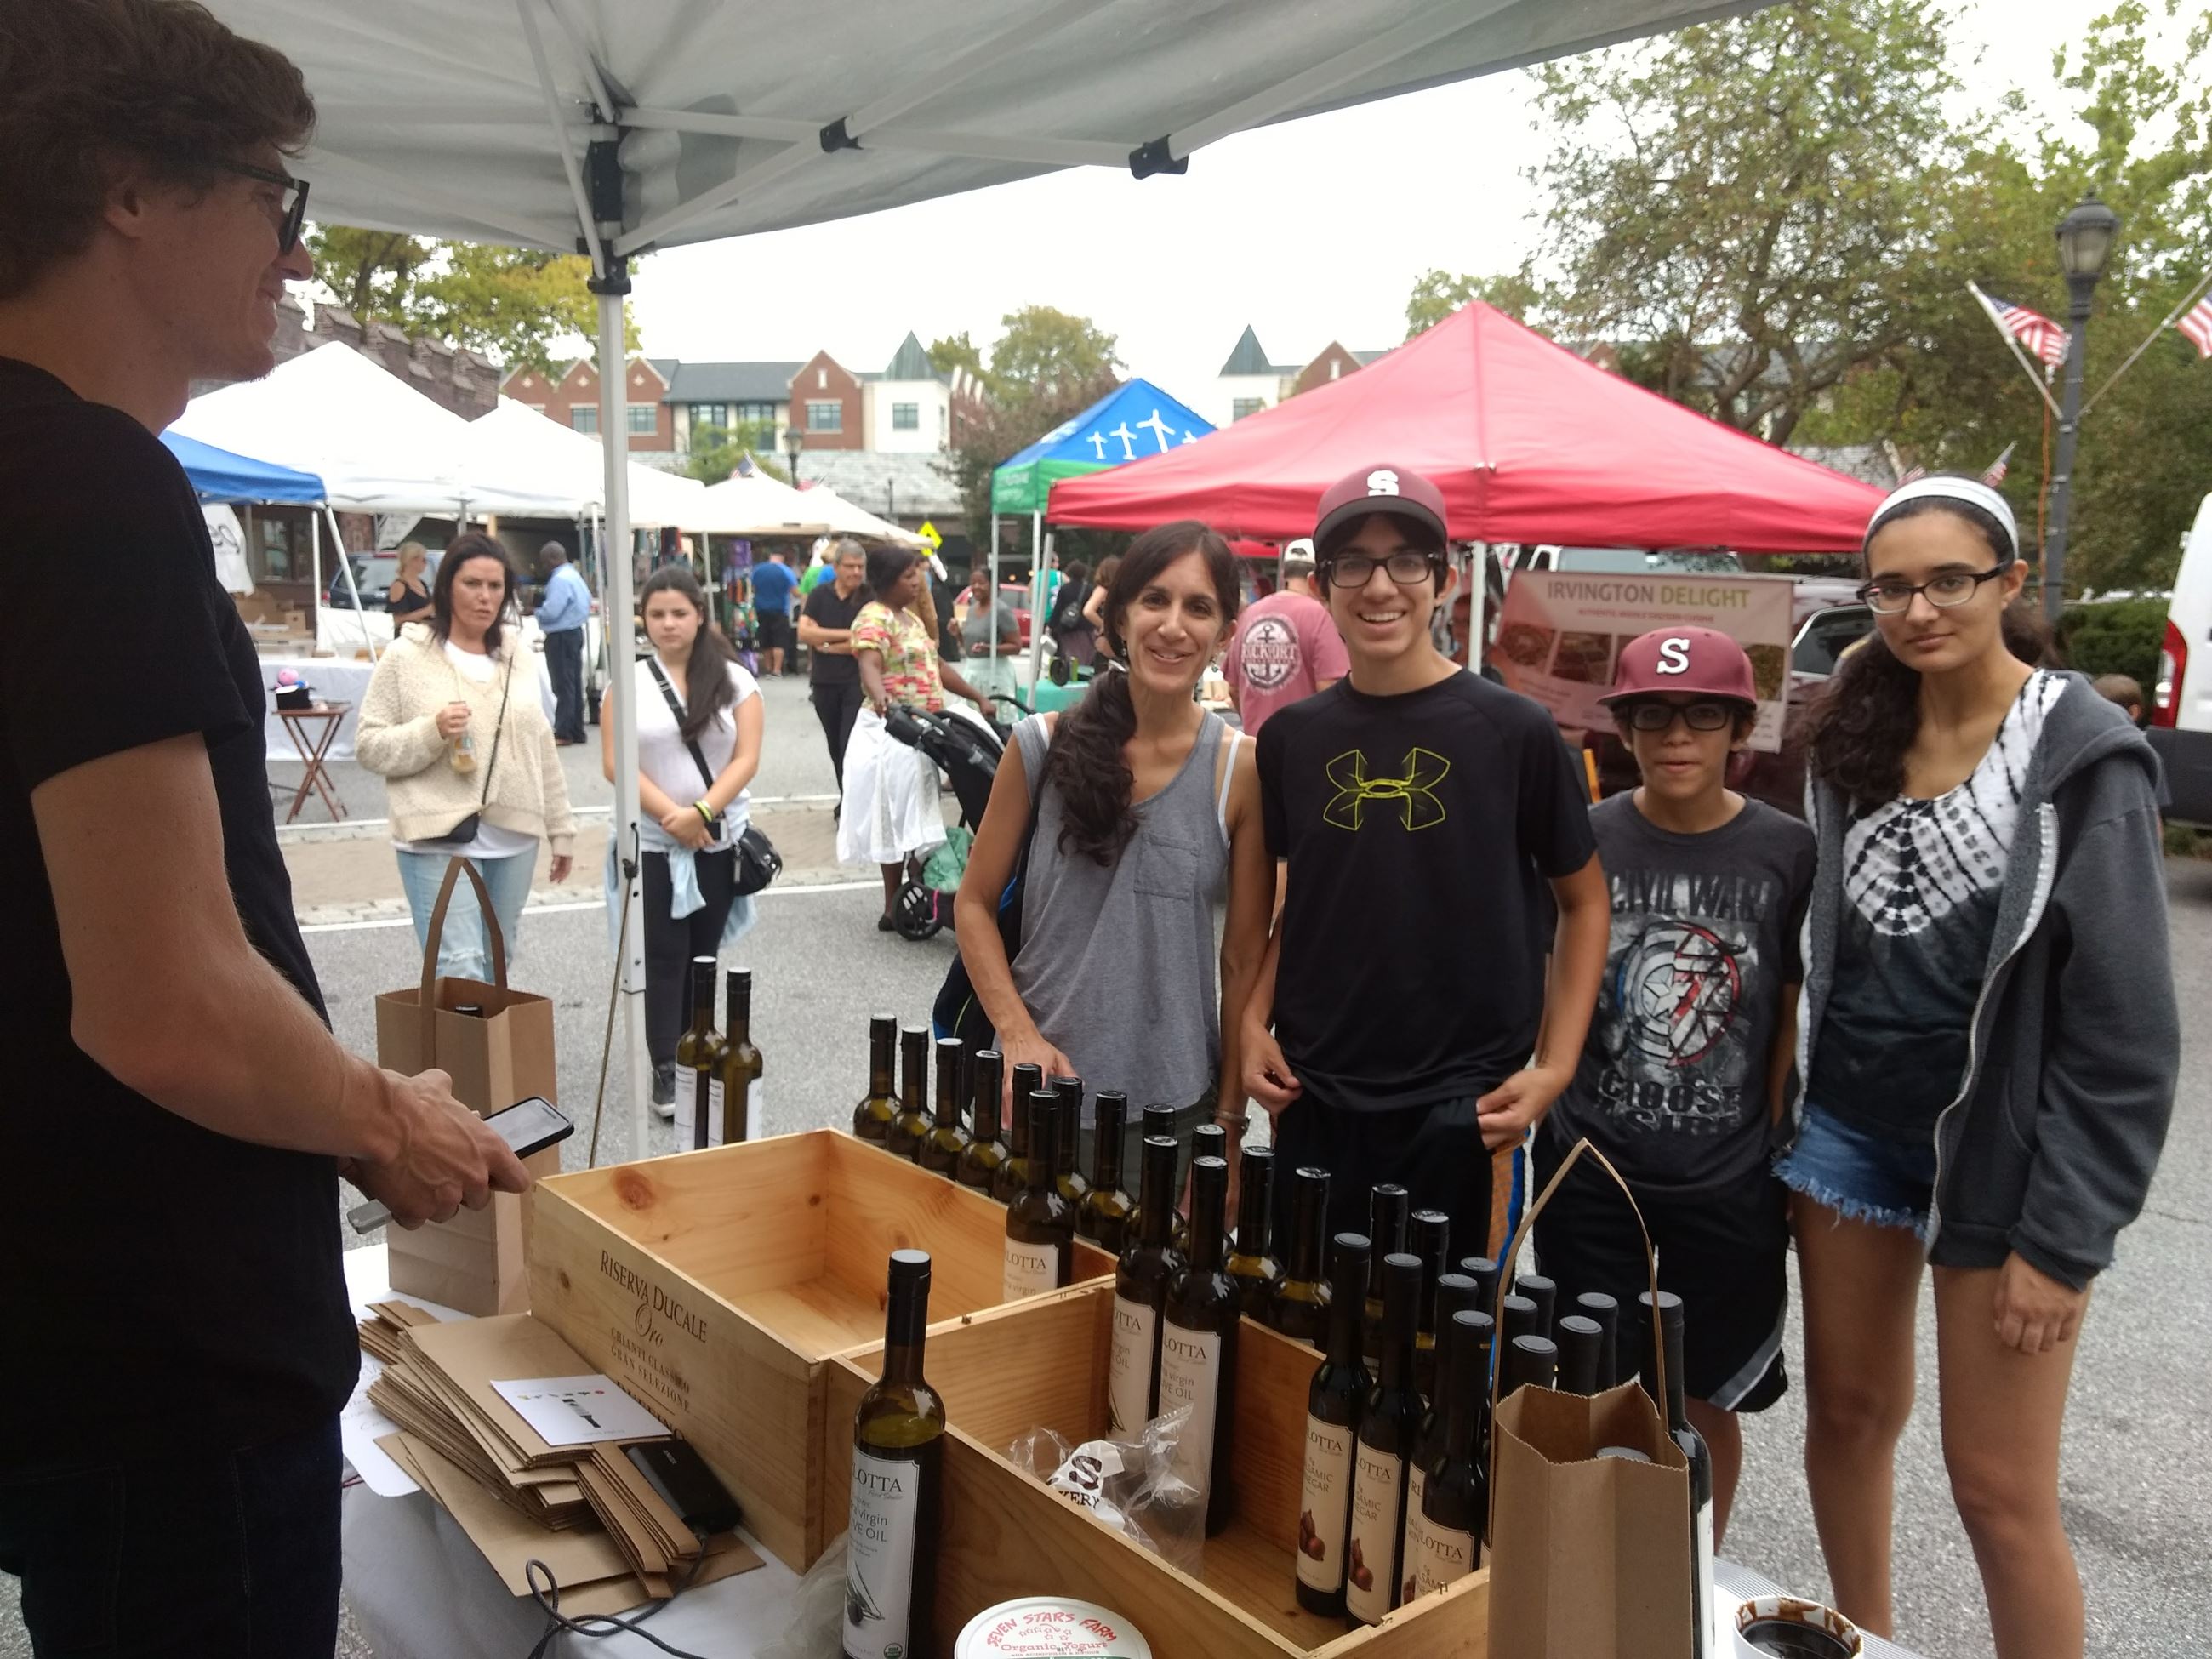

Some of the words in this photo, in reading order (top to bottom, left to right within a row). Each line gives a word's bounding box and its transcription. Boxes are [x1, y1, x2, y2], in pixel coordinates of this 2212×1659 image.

[1367, 470, 1400, 496] S
[1548, 580, 1655, 603] IRVINGTON
[1660, 585, 1751, 608] DELIGHT
[1656, 638, 1691, 675] S
[600, 1250, 649, 1304] RISERVA
[653, 1285, 709, 1344] DUCALE
[634, 1303, 665, 1348] Oro
[611, 1327, 646, 1362] CHIANTI
[611, 1343, 636, 1371] GRAN
[637, 1365, 691, 1413] SELEZIONE
[1175, 1388, 1194, 1401] OIL
[858, 1508, 887, 1527] virgin
[865, 1527, 887, 1542] OIL
[986, 1618, 1018, 1647] SEVEN
[1023, 1611, 1075, 1624] STARS
[1079, 1619, 1117, 1642] FARM
[1001, 1642, 1058, 1653] Organic
[1061, 1640, 1109, 1652] Yogurt
